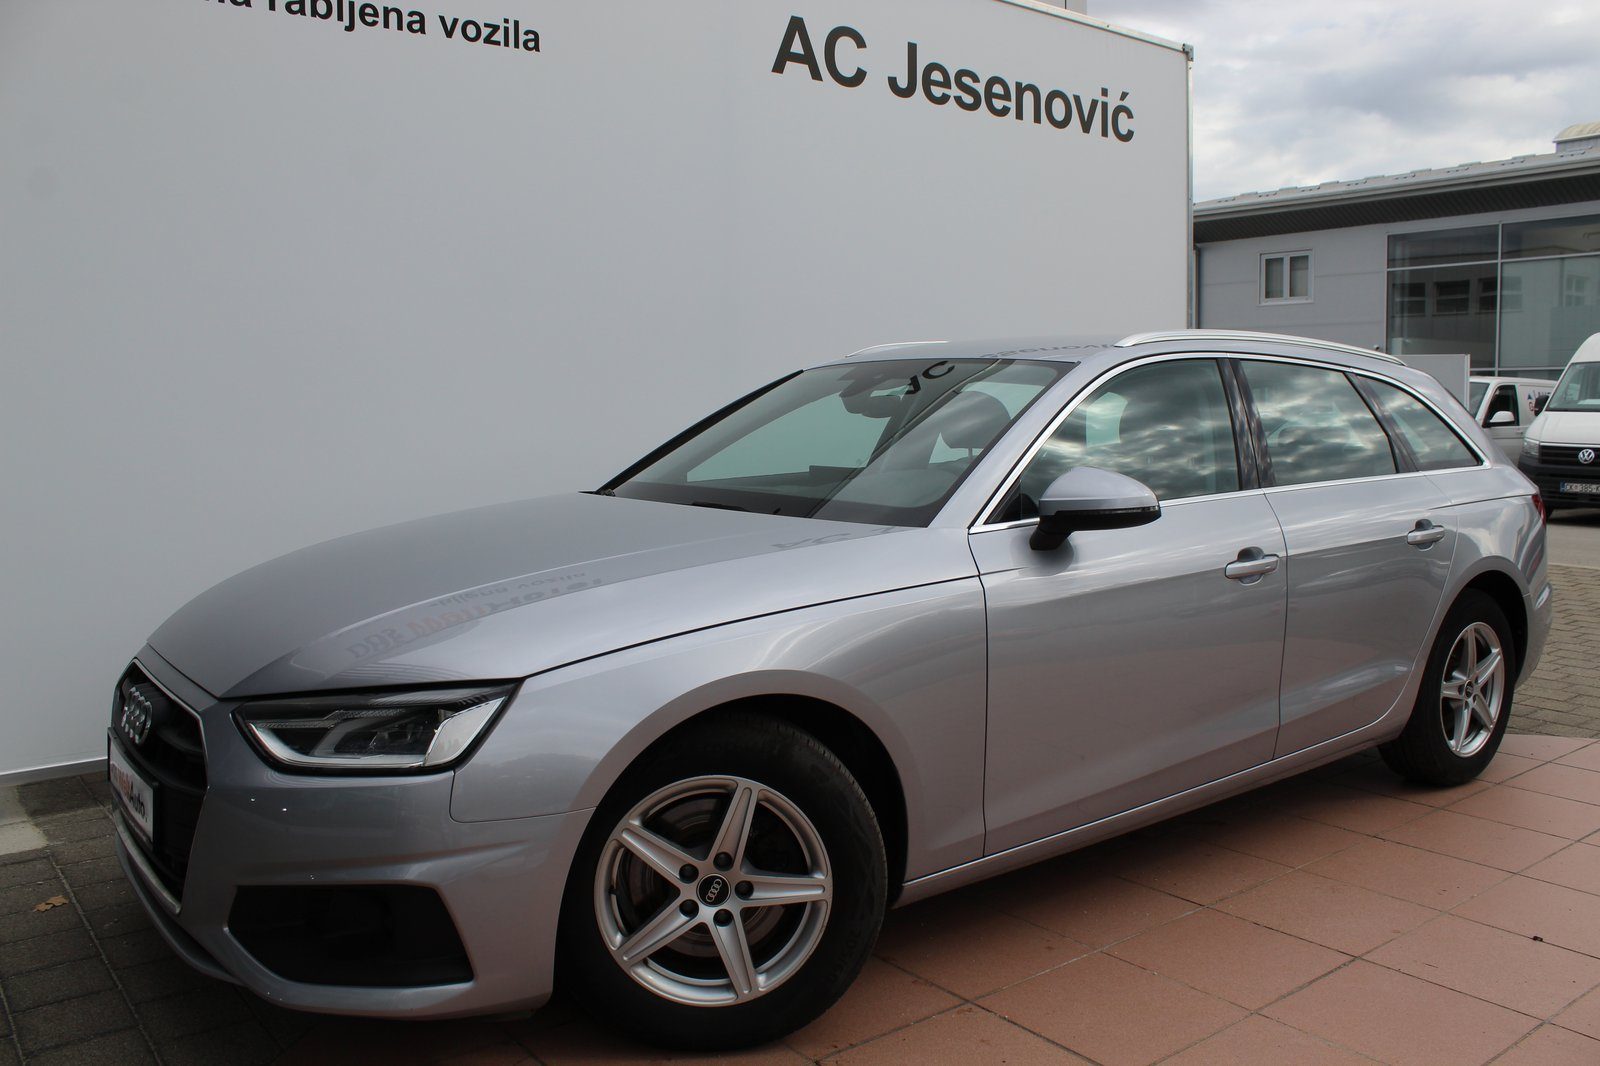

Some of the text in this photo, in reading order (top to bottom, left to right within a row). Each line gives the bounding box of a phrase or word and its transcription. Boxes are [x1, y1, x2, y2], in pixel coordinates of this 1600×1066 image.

[439, 15, 541, 53] vozila
[771, 15, 1136, 143] AC Jesenović
